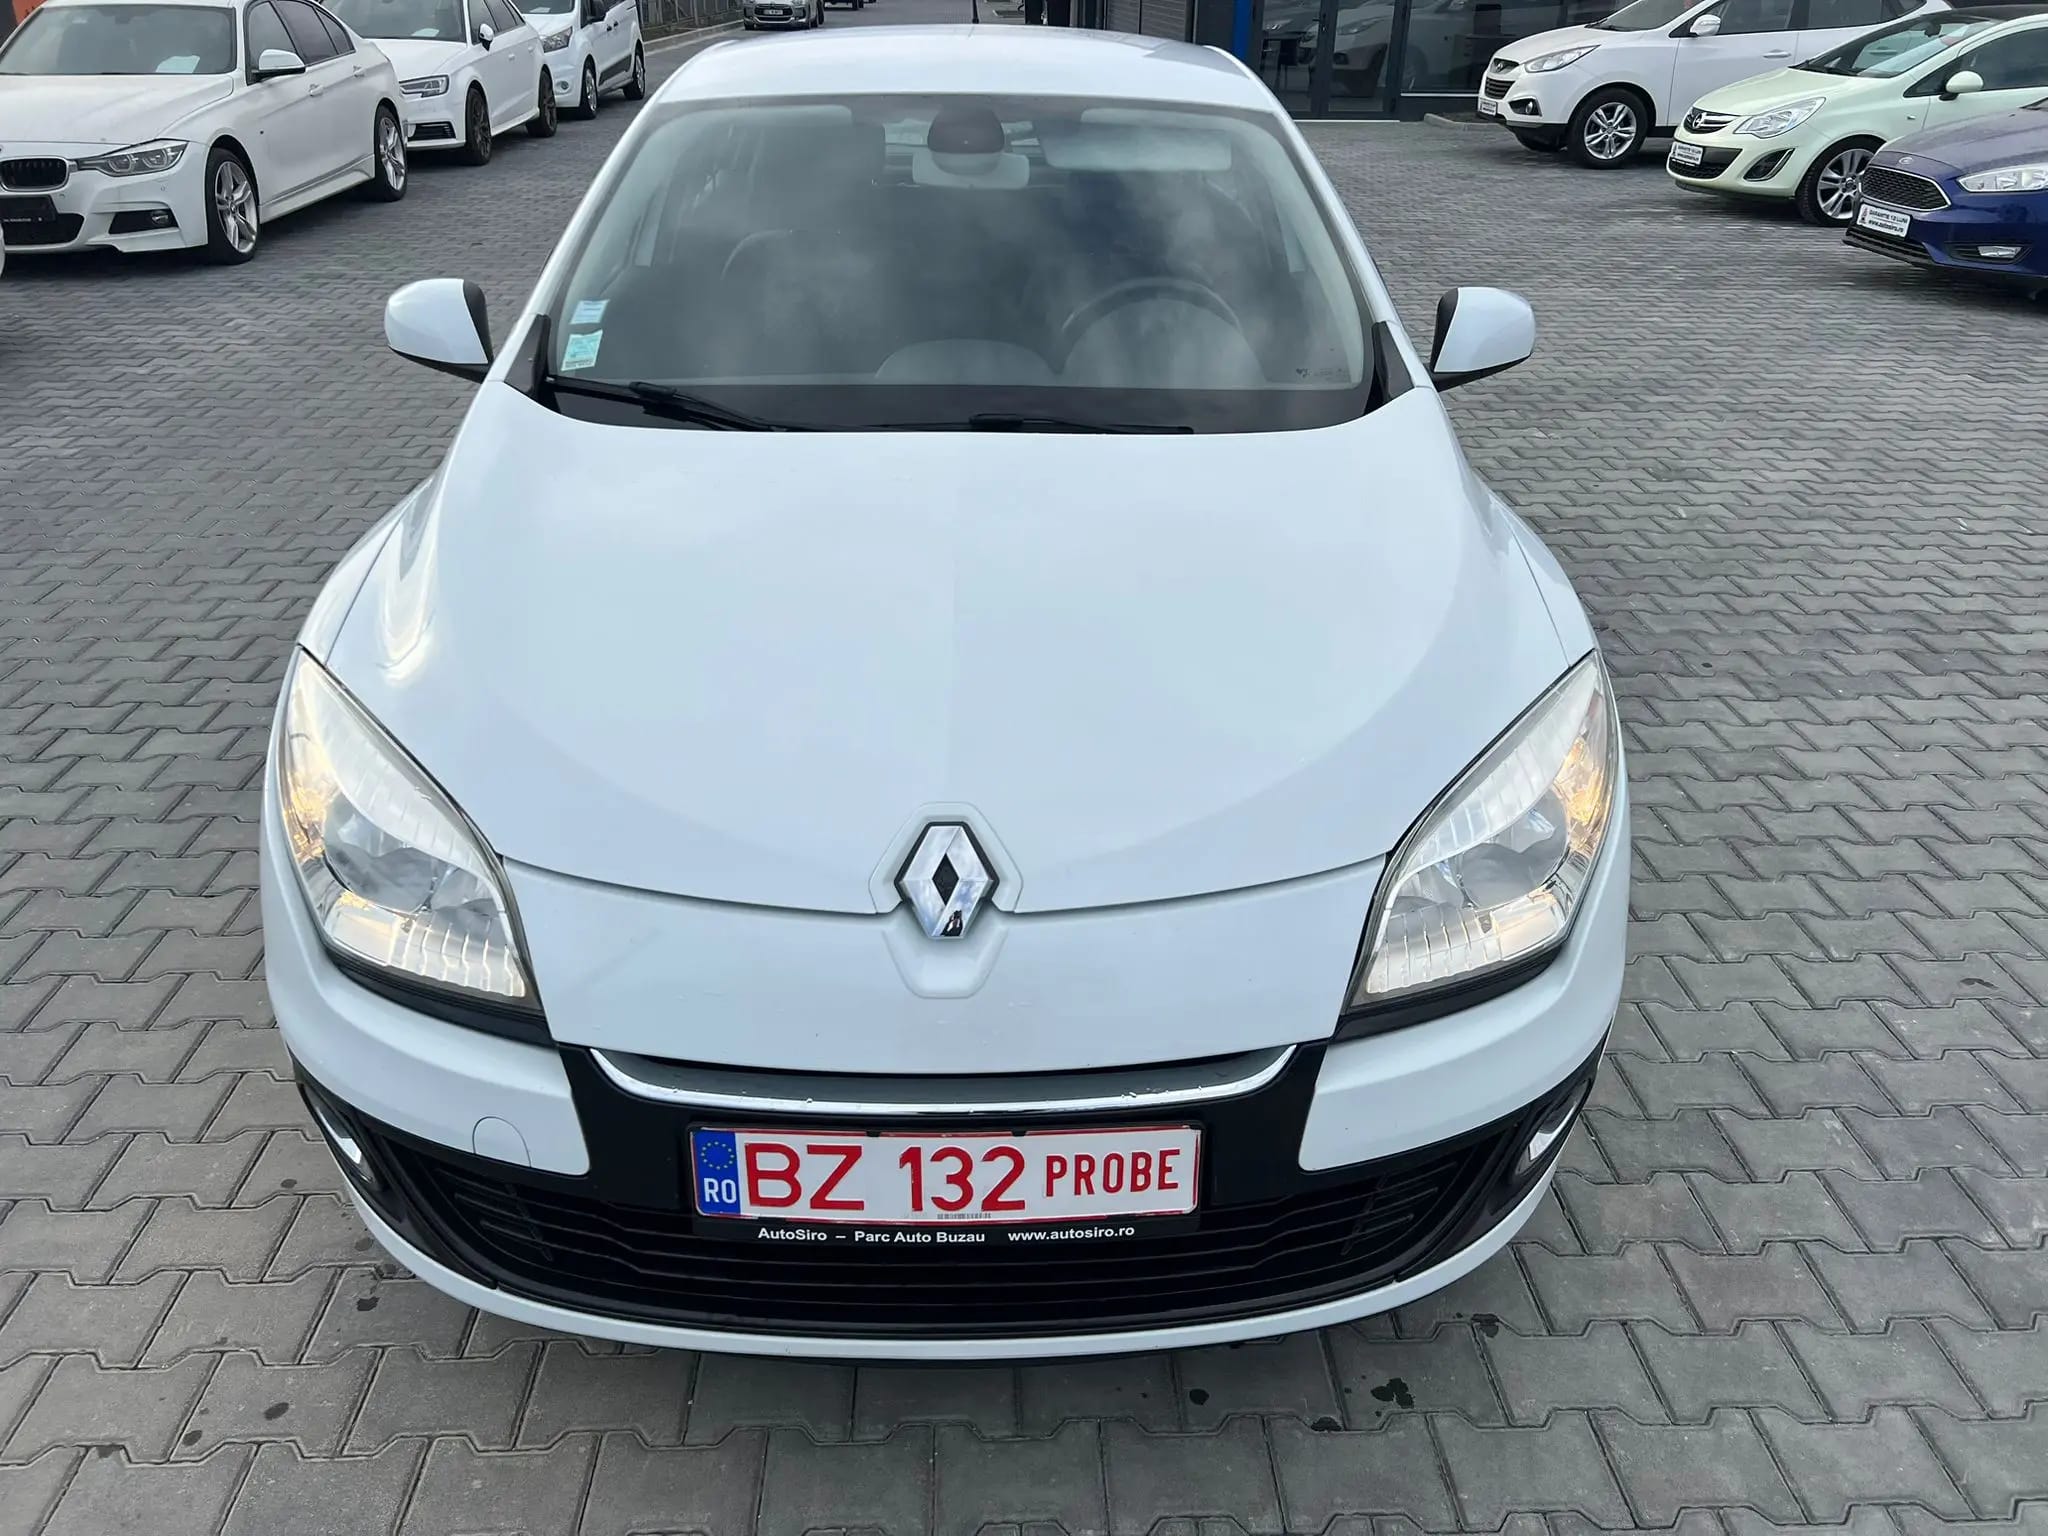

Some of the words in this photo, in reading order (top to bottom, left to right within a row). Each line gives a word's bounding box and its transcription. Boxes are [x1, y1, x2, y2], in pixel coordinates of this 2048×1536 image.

[703, 1177, 737, 1204] RO
[744, 1142, 865, 1211] BZ
[899, 1145, 1026, 1212] 132
[1045, 1148, 1181, 1197] PROBE
[757, 1227, 828, 1241] AutoSiro
[854, 1230, 891, 1243] Parc
[893, 1231, 932, 1243] Auto
[936, 1231, 986, 1243] Buzau
[1007, 1226, 1136, 1242] www.autosiro.ro
